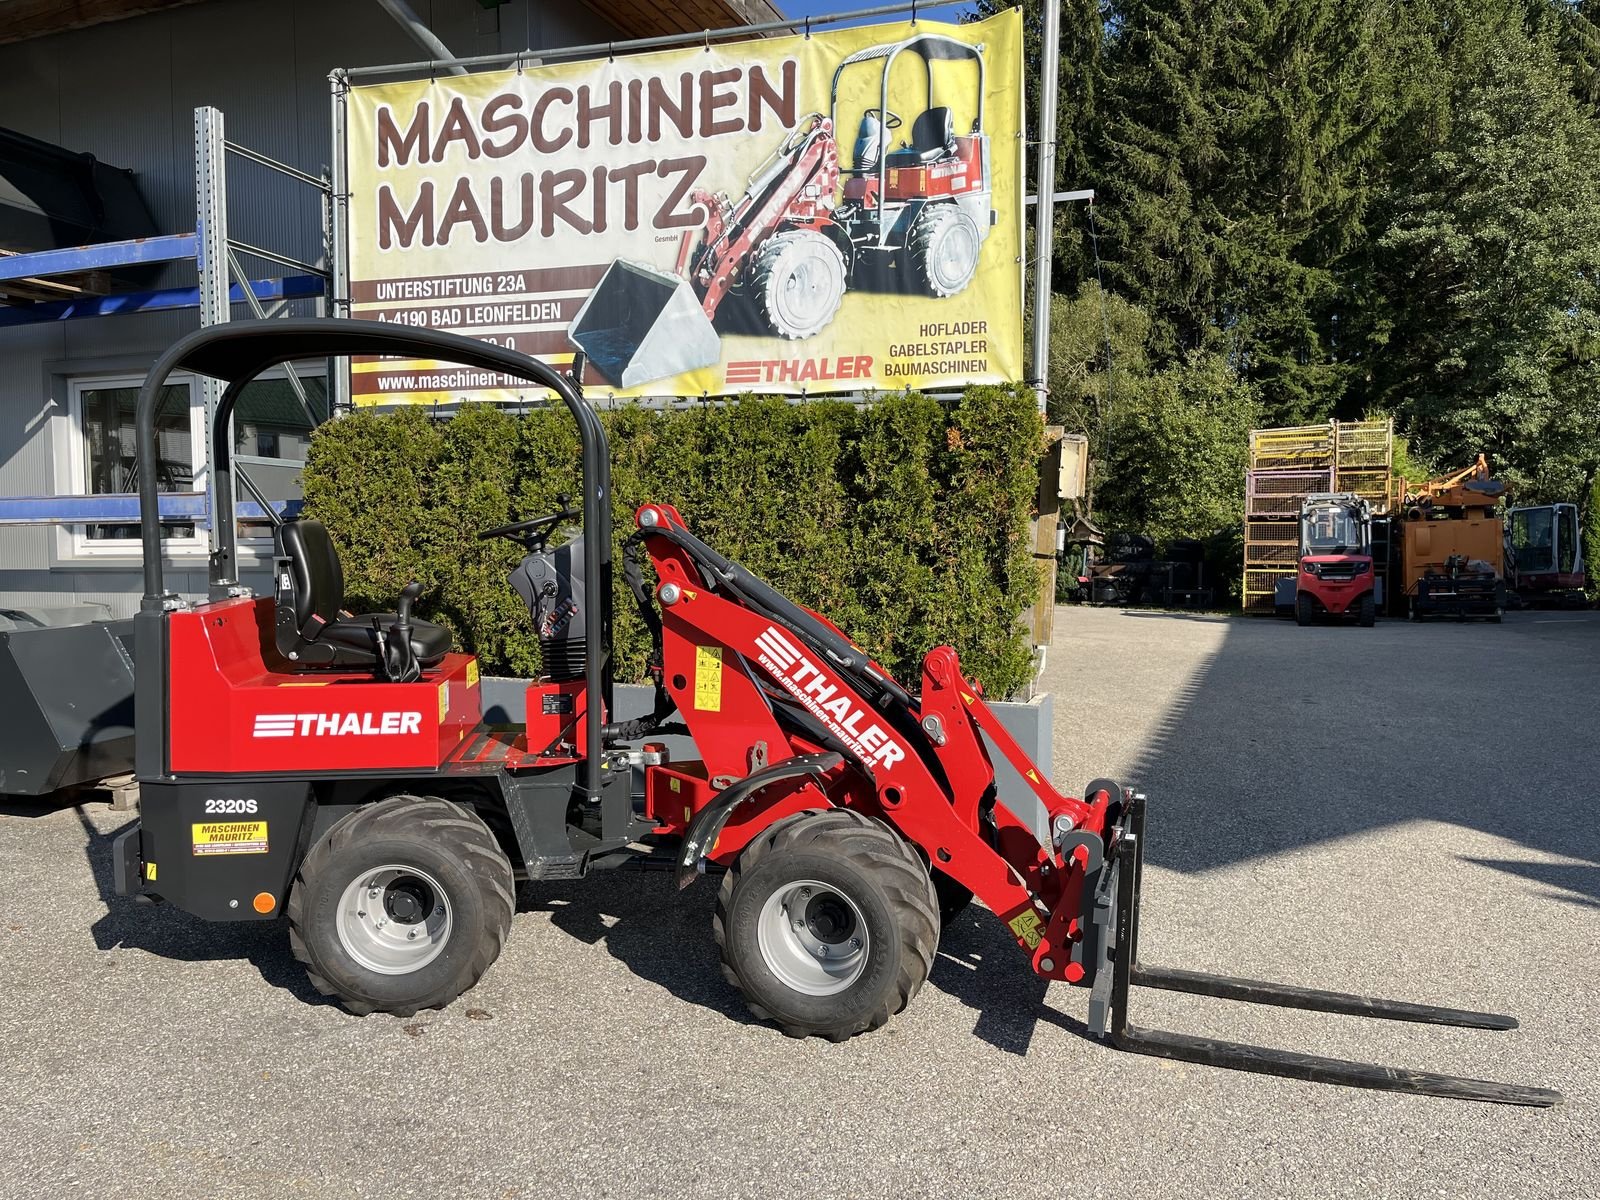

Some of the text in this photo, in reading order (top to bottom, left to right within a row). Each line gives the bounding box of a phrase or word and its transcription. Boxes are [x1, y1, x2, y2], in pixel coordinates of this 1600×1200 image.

[377, 60, 797, 168] MASCHINEN
[378, 155, 708, 250] MAURITZ
[654, 235, 679, 243] GesmbH
[376, 274, 527, 300] UNTERSTIFTUNG 23A
[377, 302, 561, 327] A-4190 BAD LEONFELDEN
[919, 321, 987, 337] HOFLADER
[889, 340, 987, 358] GABELSTAPLER
[760, 355, 874, 384] THALER
[884, 359, 987, 377] BAUMASCHINEN
[757, 653, 878, 768] www.maschinen-mauritz.at
[791, 656, 906, 772] THALER
[296, 711, 422, 737] THALER
[205, 799, 258, 814] 2320S
[201, 823, 260, 834] MASCHINEN
[209, 832, 253, 842] MAURITZ
